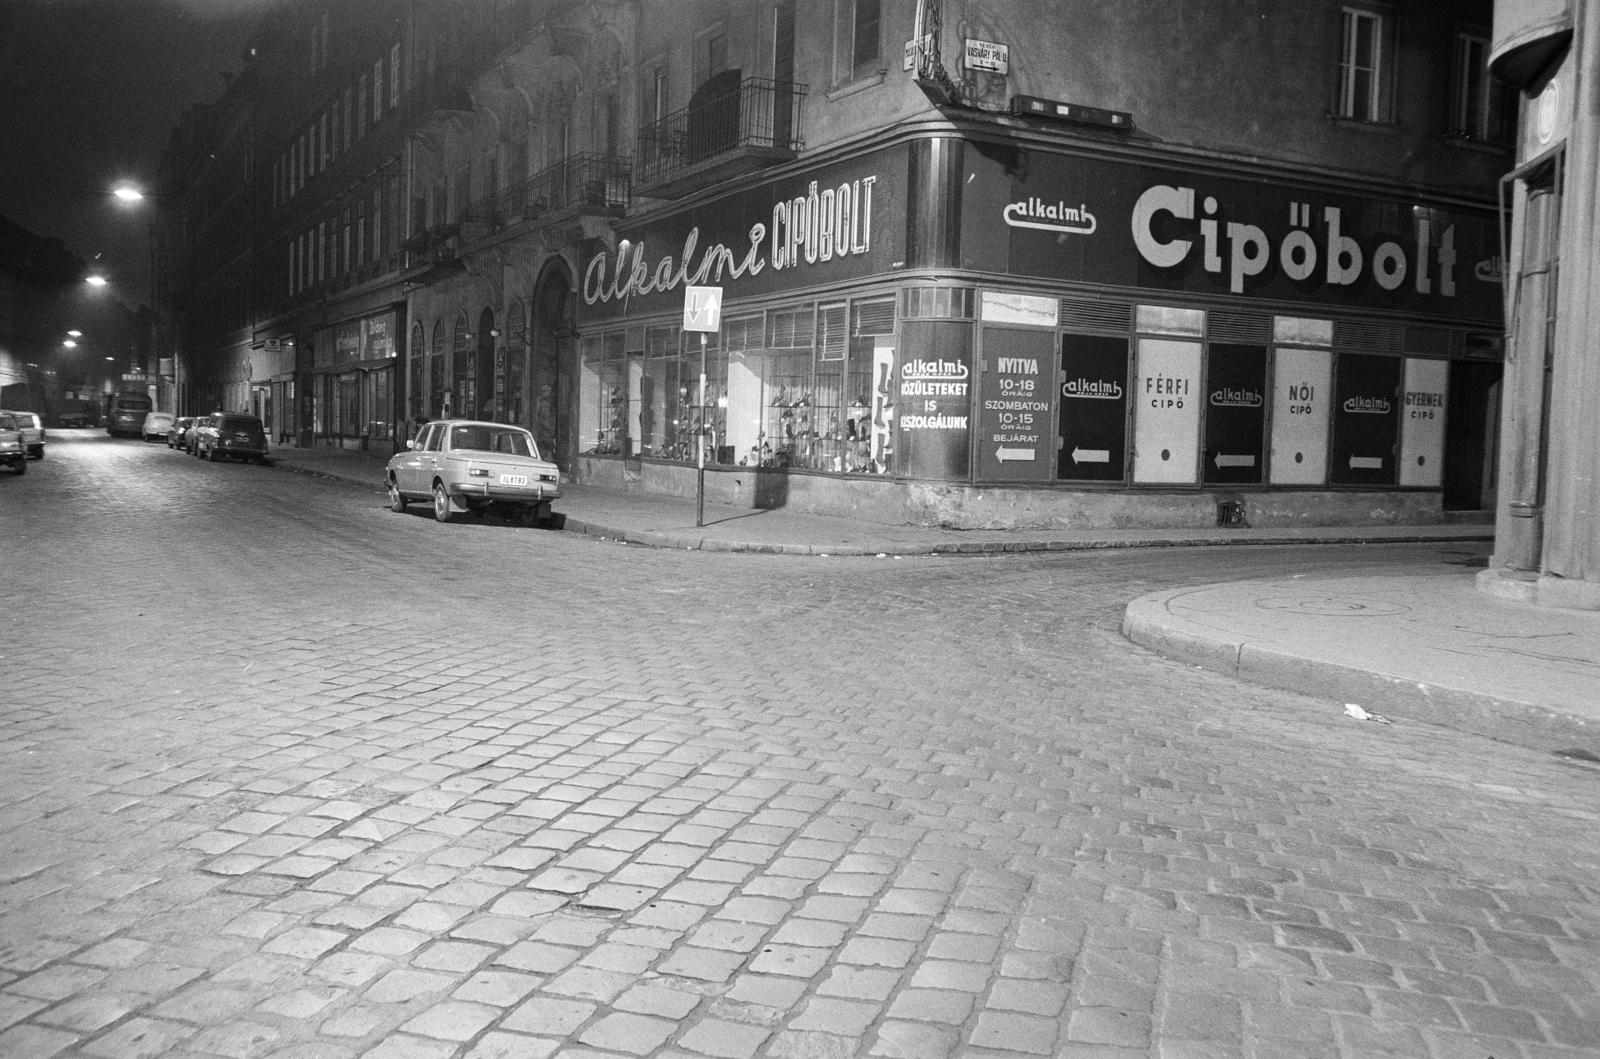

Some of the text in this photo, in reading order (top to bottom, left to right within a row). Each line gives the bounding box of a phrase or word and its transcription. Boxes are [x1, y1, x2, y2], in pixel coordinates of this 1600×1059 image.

[1013, 196, 1088, 223] alkalmi
[583, 222, 766, 305] alkalmi
[904, 358, 962, 374] alkalmi
[998, 357, 1038, 375] NYITVA
[999, 379, 1034, 391] 10-18
[1067, 378, 1117, 394] alkalmi
[1146, 373, 1189, 395] FÉRFI
[1289, 381, 1314, 402] NŐI
[1001, 389, 1033, 397] ÓRÁIG
[1214, 387, 1258, 403] alkalmi
[1406, 391, 1444, 408] GYERMEK
[924, 400, 937, 412] IS
[984, 400, 1049, 412] SZOMBATON
[1151, 396, 1184, 409] CIPŐ
[1347, 395, 1388, 409] alkalmi
[999, 412, 1034, 424] 10-15
[1000, 423, 1032, 431] ÓRÁIG
[993, 433, 1039, 443] BEJÁRAT
